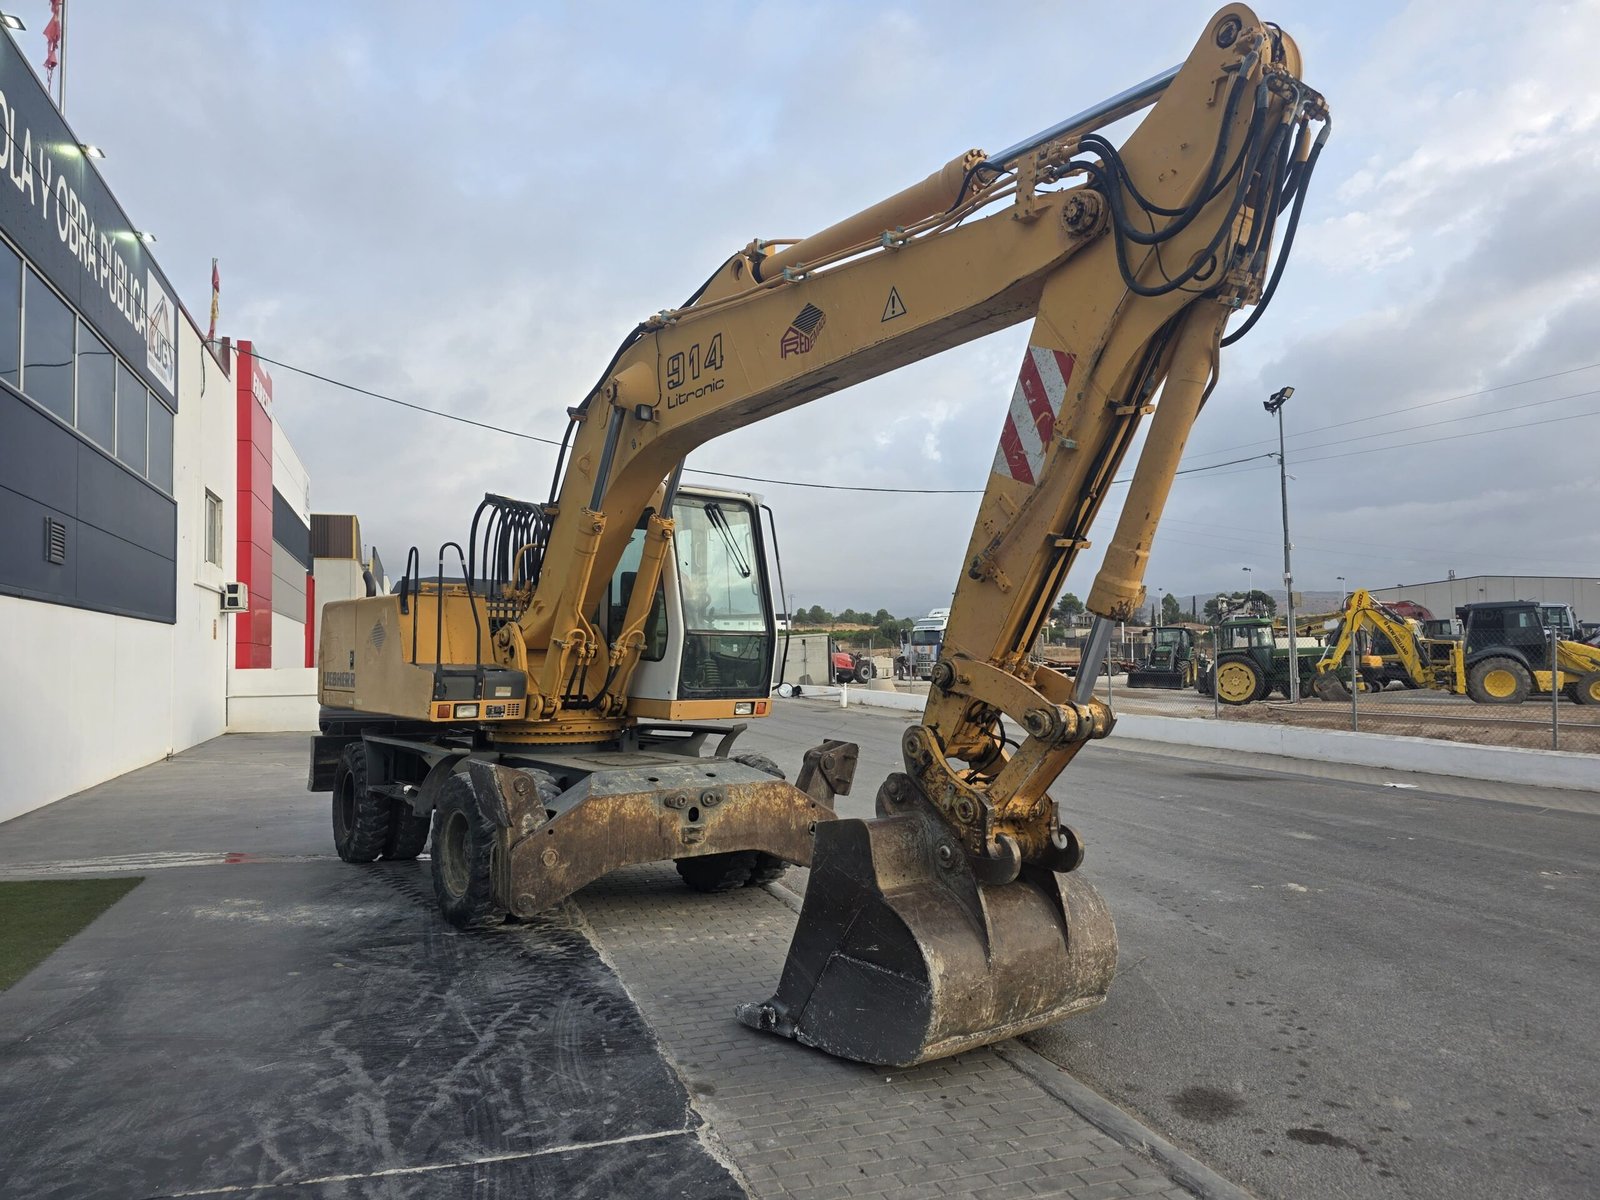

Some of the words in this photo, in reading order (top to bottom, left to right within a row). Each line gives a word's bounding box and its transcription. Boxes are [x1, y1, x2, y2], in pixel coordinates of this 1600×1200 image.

[39, 147, 52, 220] Y
[56, 174, 98, 282] OBRA
[100, 238, 147, 341] PÚBLICA
[667, 332, 724, 390] 914
[667, 377, 725, 410] Litronic
[1393, 634, 1409, 656] HOLLAND
